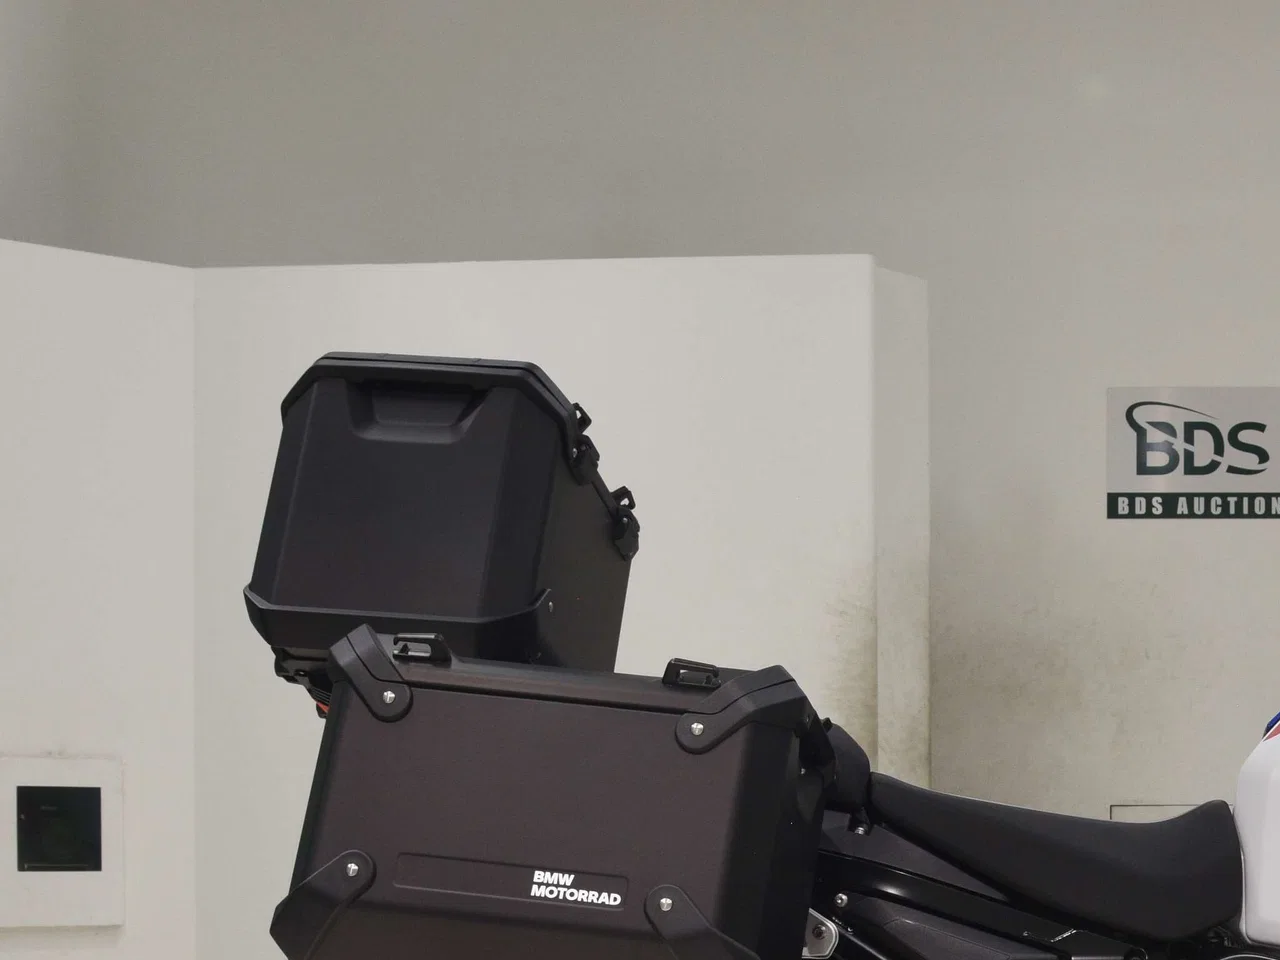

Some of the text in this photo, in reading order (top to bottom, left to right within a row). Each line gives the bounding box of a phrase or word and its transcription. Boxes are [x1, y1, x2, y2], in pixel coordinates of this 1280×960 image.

[1125, 401, 1270, 476] BDS
[1117, 496, 1164, 515] BDS
[533, 870, 574, 886] BMW
[530, 884, 622, 906] MOTORRAD
